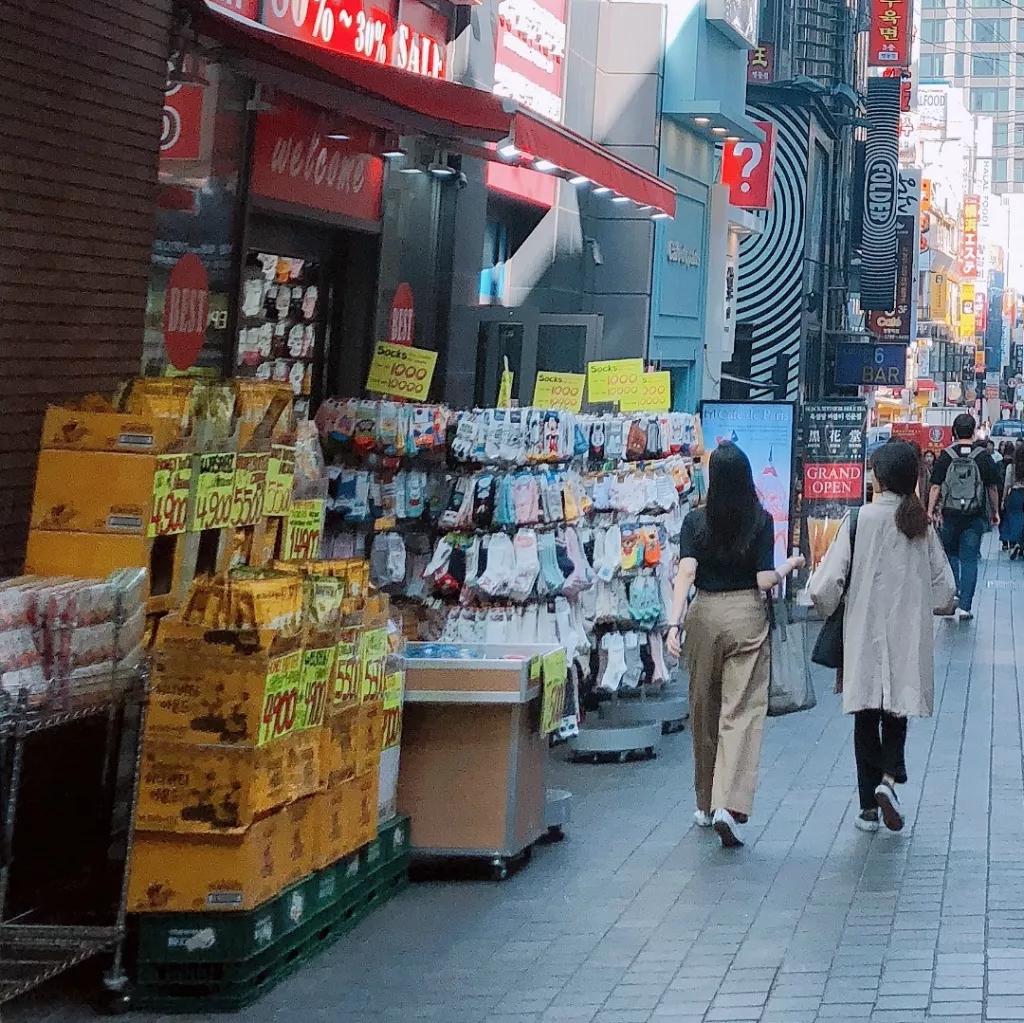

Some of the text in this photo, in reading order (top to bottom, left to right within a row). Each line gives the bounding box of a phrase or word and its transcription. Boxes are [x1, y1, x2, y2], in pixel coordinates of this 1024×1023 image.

[868, 163, 893, 223] FOLDER
[377, 345, 408, 361] Socks
[874, 347, 885, 364] 6
[861, 366, 901, 384] BAR
[806, 466, 861, 480] GRAND
[812, 481, 852, 494] OPEN
